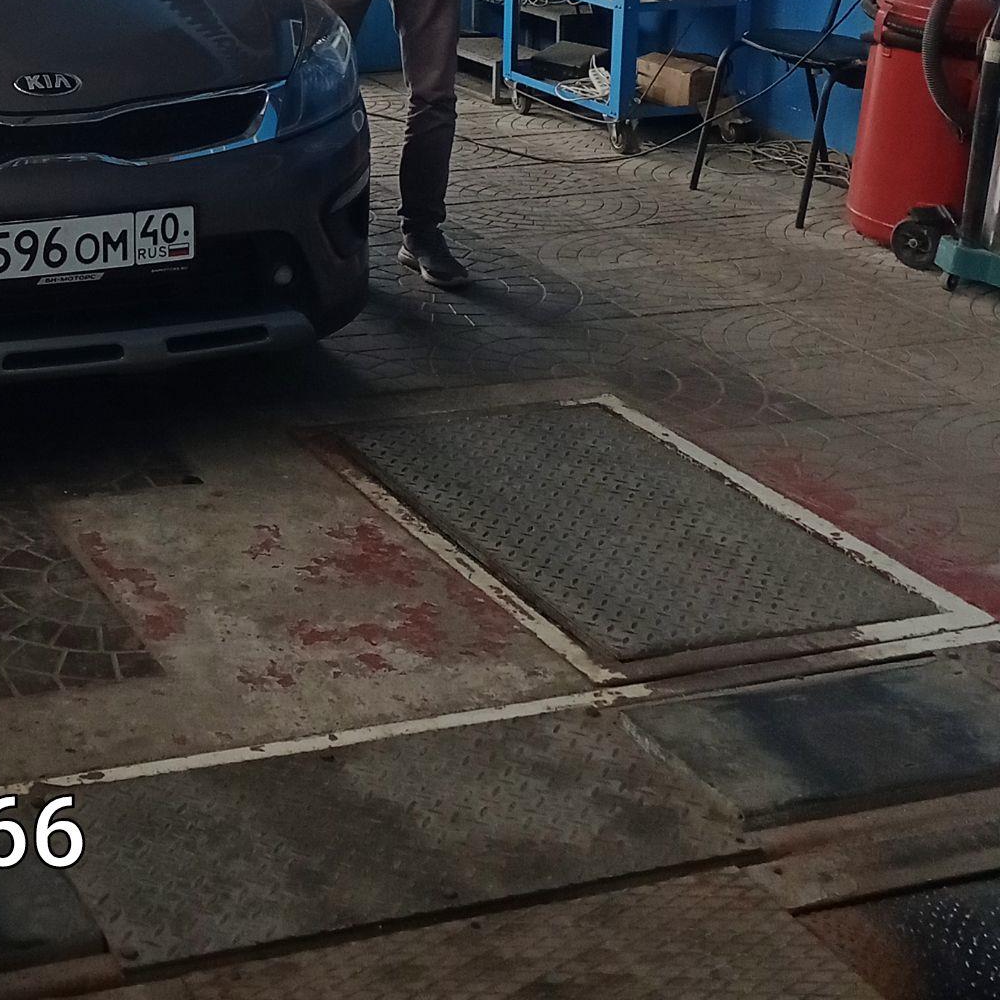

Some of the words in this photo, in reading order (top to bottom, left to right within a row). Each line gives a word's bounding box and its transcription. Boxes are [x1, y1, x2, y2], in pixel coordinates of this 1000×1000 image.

[24, 73, 72, 90] KIA
[139, 212, 180, 247] 40
[137, 245, 167, 261] RUS
